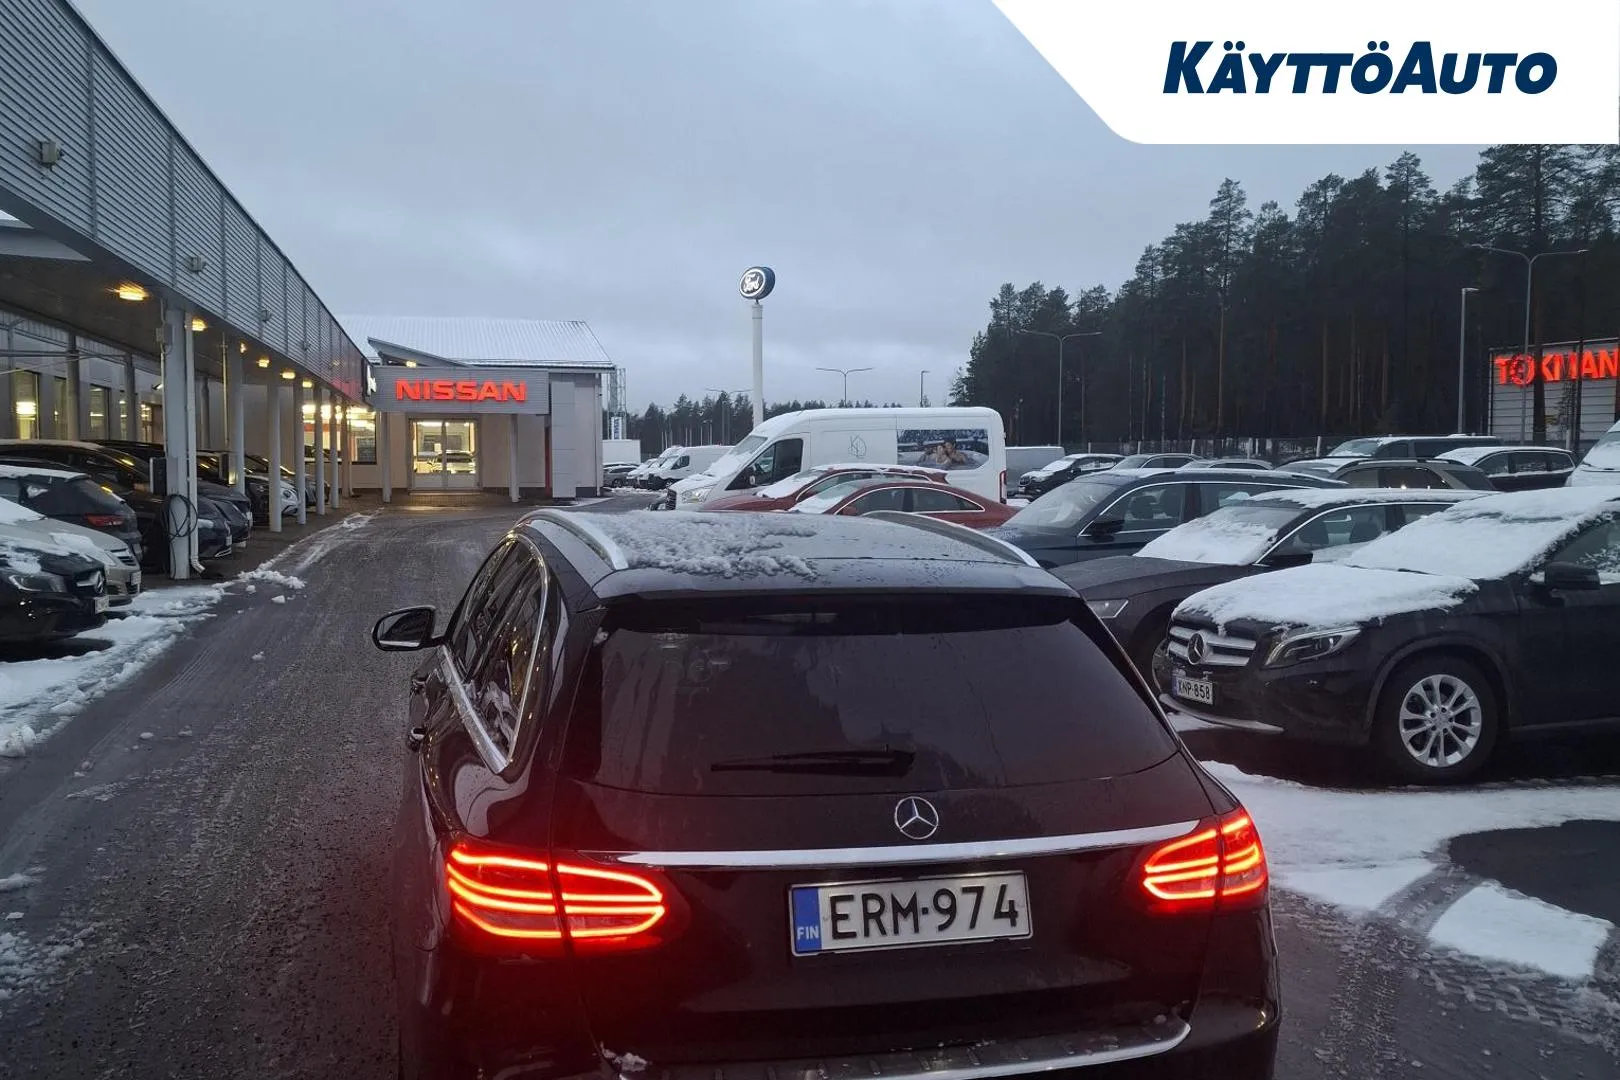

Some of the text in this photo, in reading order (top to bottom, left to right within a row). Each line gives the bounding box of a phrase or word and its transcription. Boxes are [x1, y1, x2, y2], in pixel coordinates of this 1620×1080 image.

[396, 378, 527, 402] NISSAN
[797, 884, 1018, 940] FIN ERM-974
